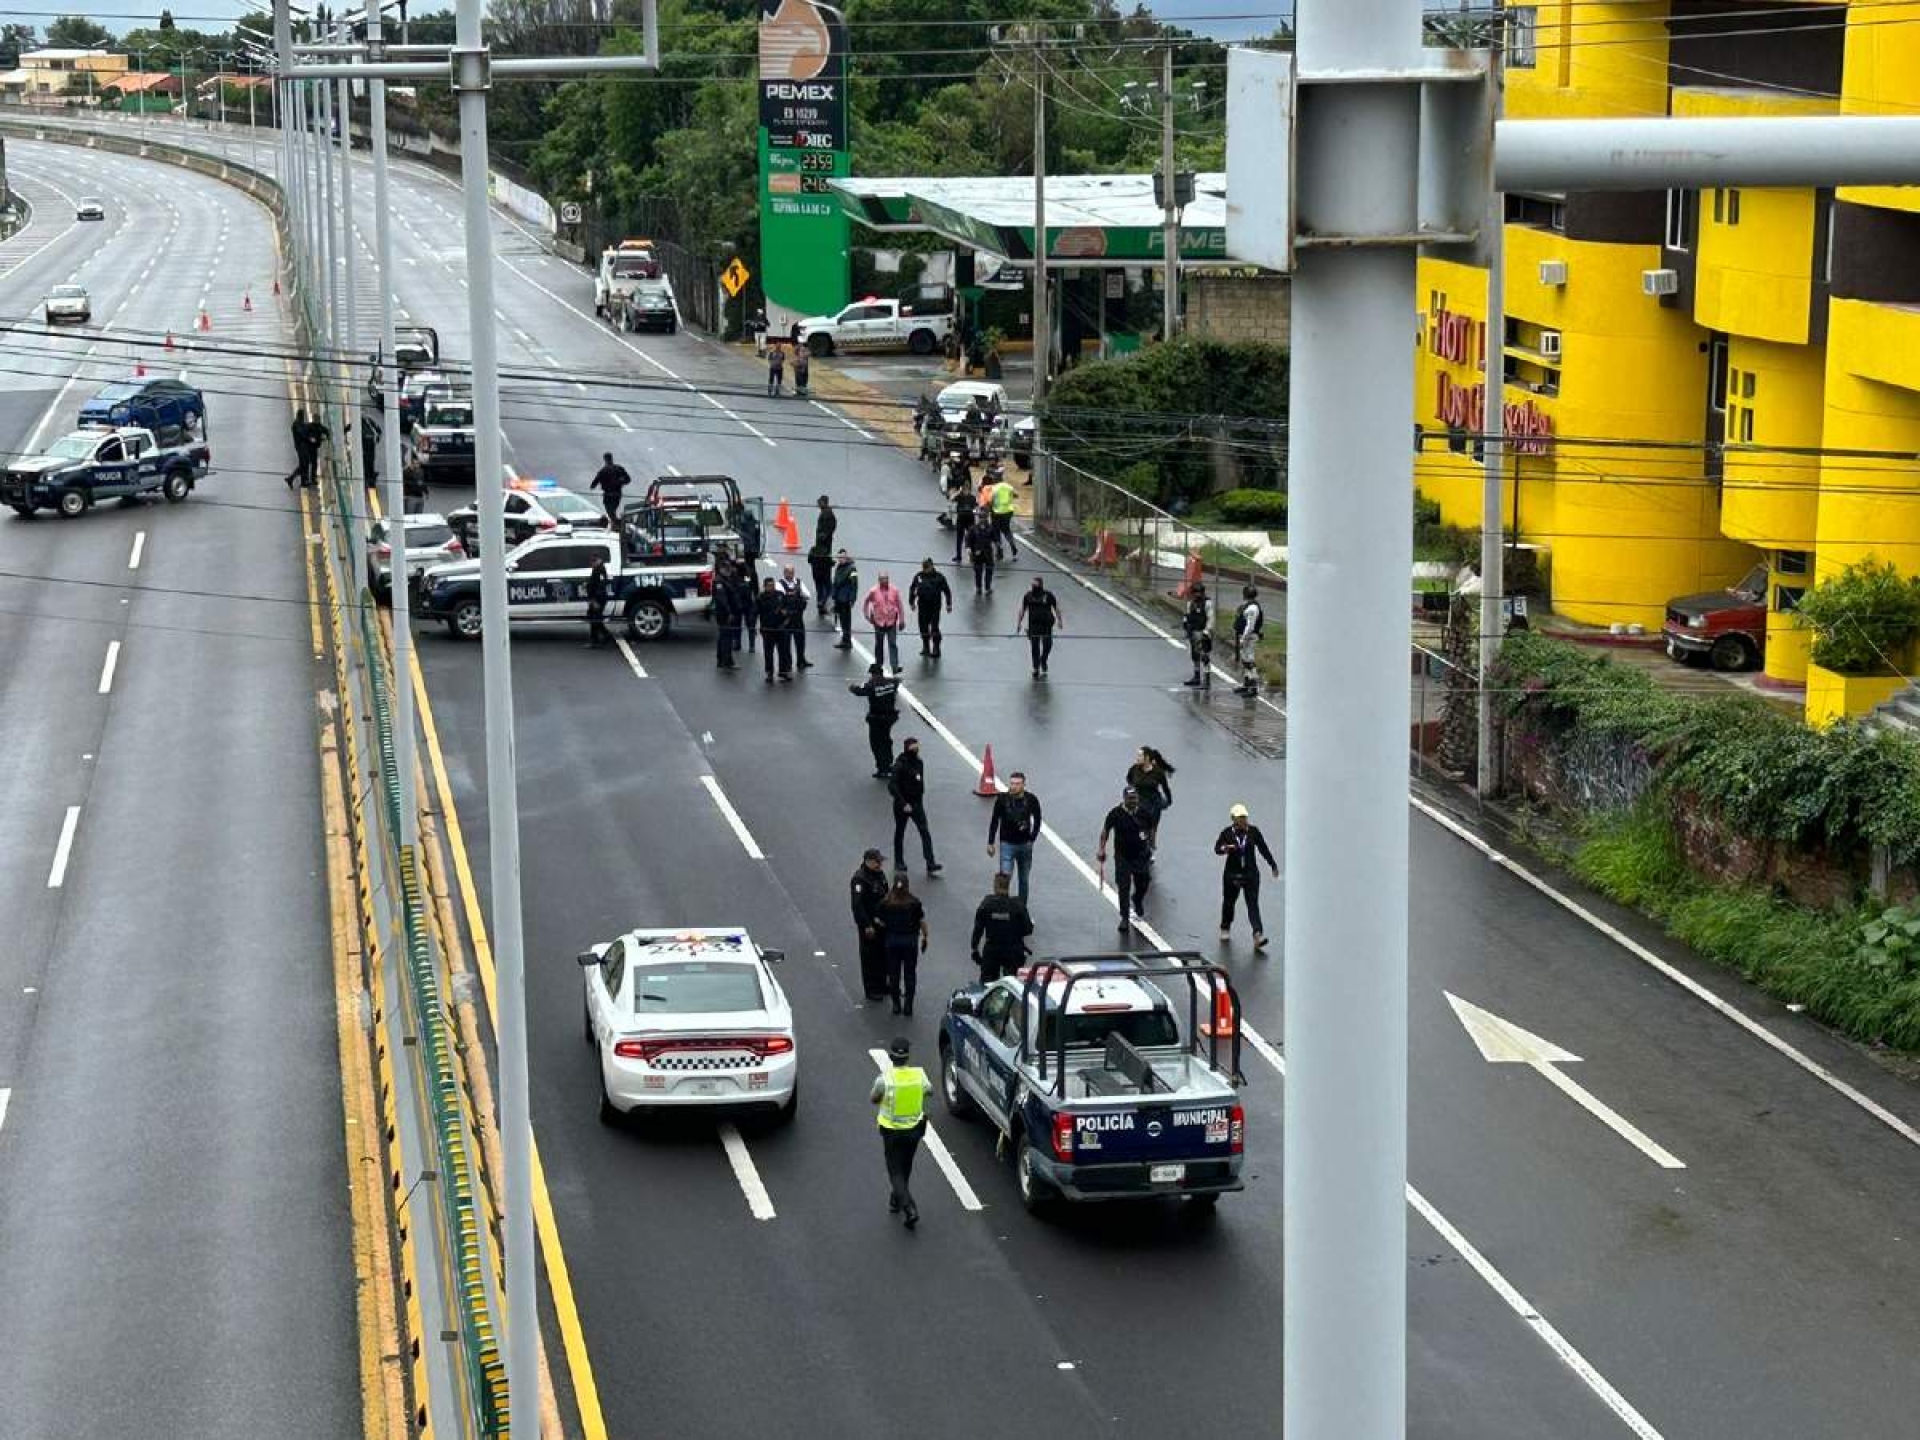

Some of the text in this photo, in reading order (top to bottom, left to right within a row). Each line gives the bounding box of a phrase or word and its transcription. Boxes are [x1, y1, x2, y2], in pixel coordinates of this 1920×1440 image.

[766, 84, 833, 100] PEMEX
[1149, 231, 1226, 249] PME
[1076, 1109, 1227, 1132] POLICÍA MUNICIPAL
